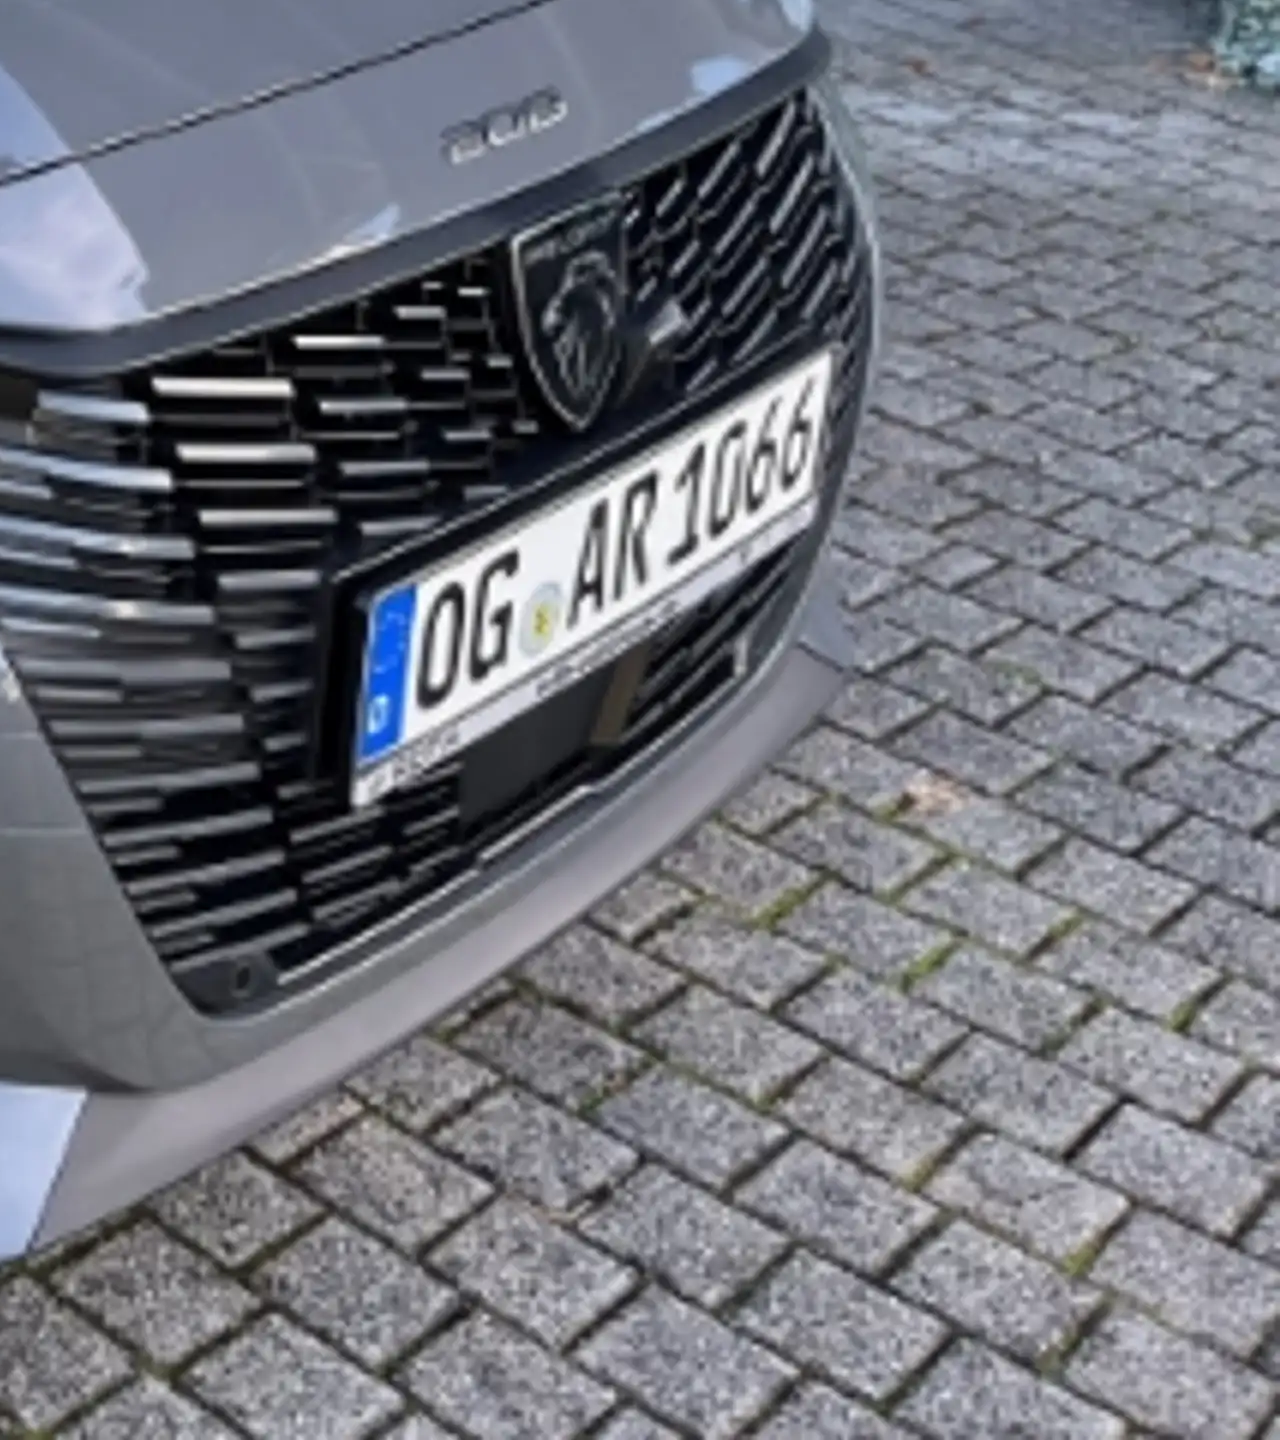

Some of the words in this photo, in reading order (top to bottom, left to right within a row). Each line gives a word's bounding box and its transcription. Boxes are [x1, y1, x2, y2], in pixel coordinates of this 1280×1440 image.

[417, 554, 520, 709] OG
[566, 467, 658, 628] AR
[666, 375, 815, 567] 1066
